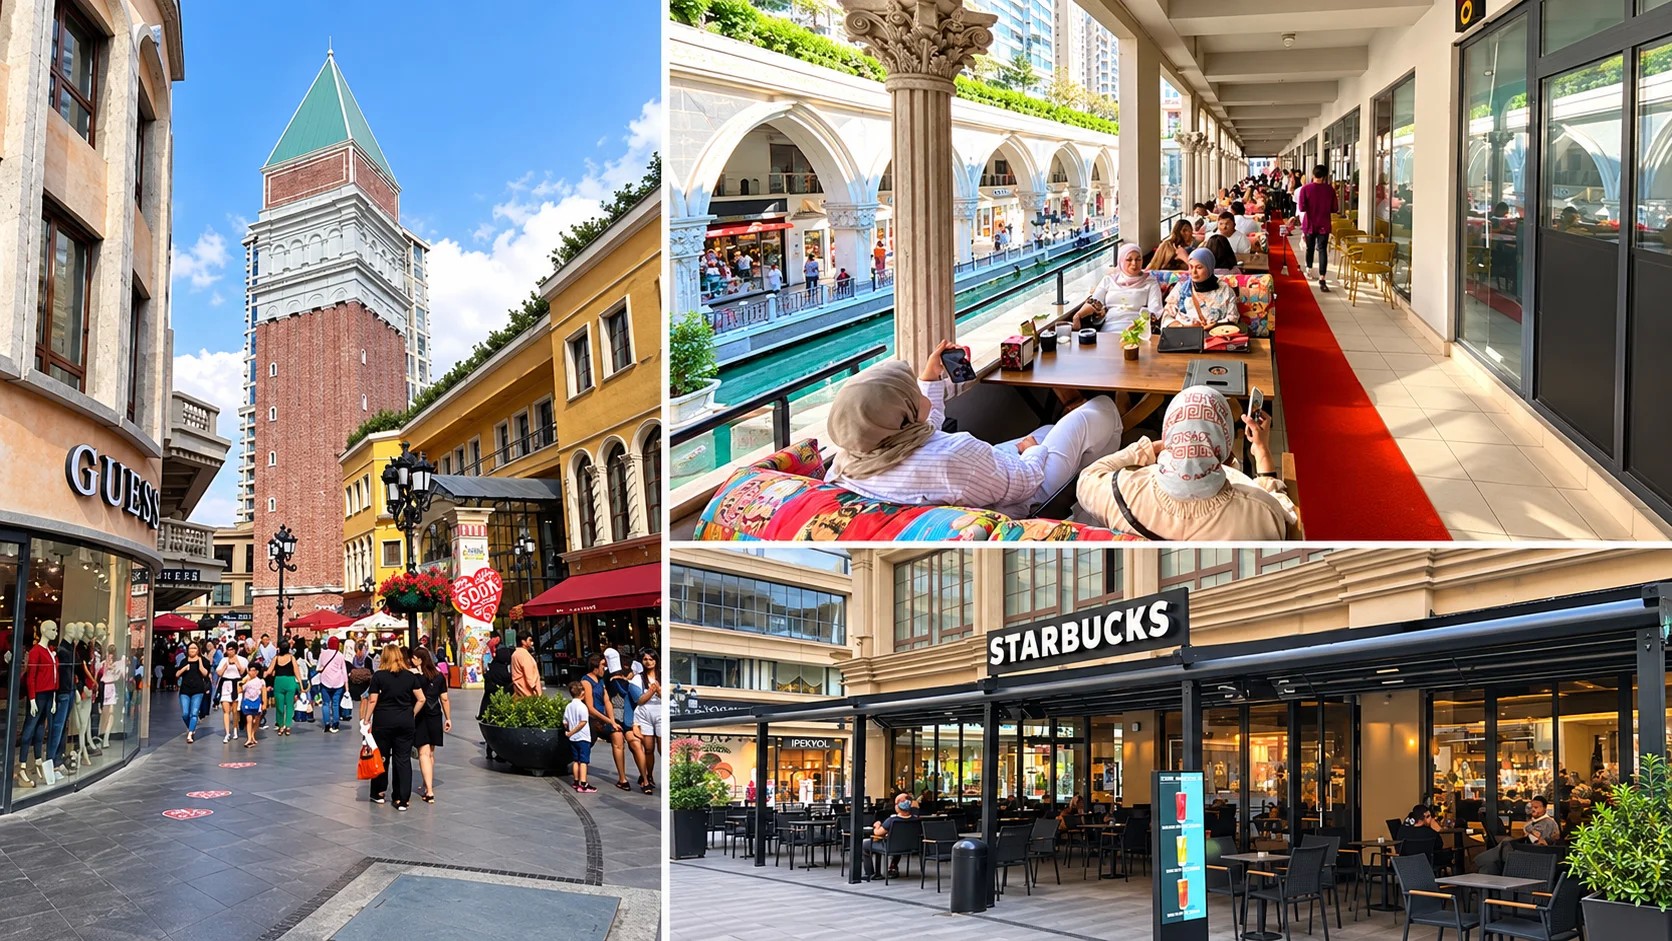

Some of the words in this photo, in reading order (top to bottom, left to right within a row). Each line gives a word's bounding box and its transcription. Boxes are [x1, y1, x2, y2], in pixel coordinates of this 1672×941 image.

[67, 443, 160, 530] GUESS
[989, 599, 1170, 666] STARBUCKS
[791, 738, 831, 748] IPEKYOL
